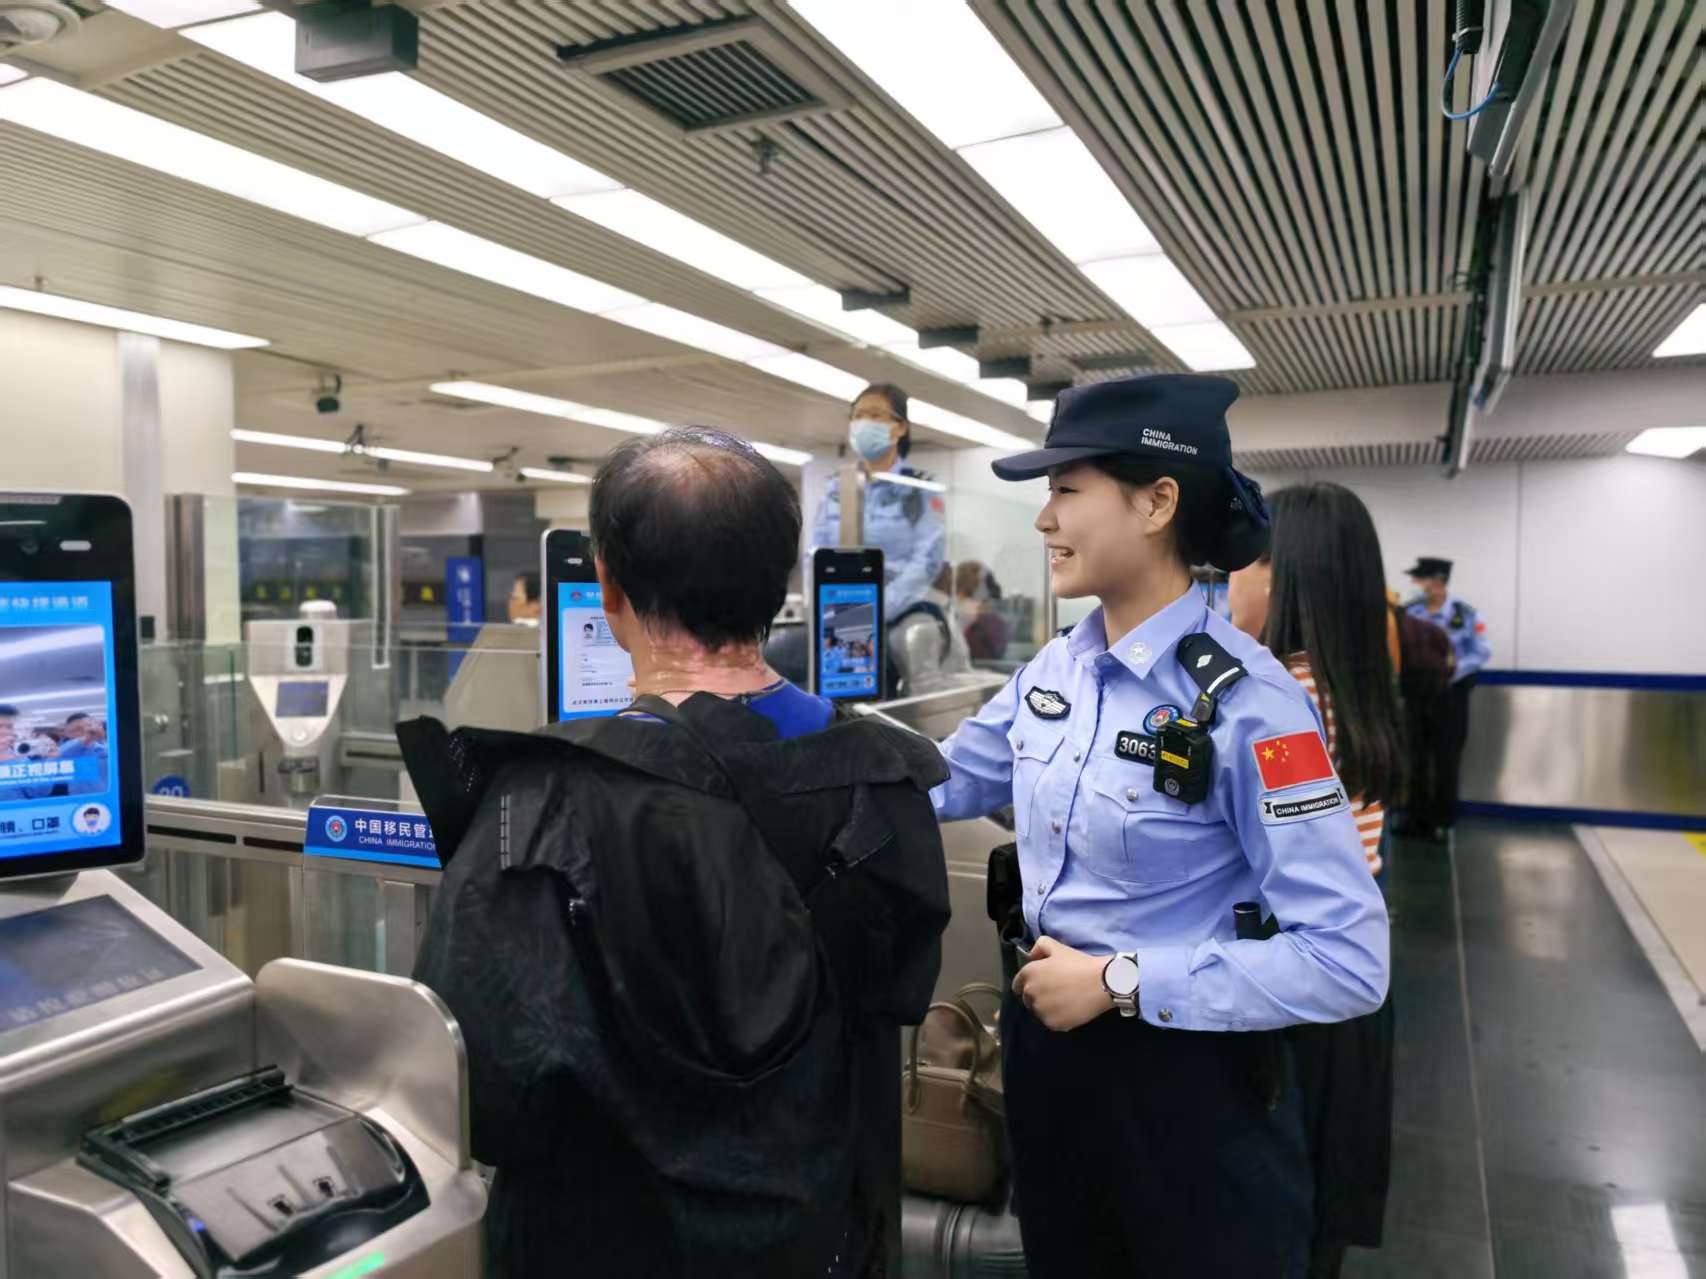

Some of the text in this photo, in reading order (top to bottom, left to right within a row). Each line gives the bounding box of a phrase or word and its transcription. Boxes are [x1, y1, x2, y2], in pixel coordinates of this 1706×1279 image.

[1143, 428, 1171, 441] CHINA
[1141, 436, 1198, 455] IMMIGRATION
[1276, 797, 1339, 816] CHINA IMMIGRATION
[359, 835, 383, 845] CHINA
